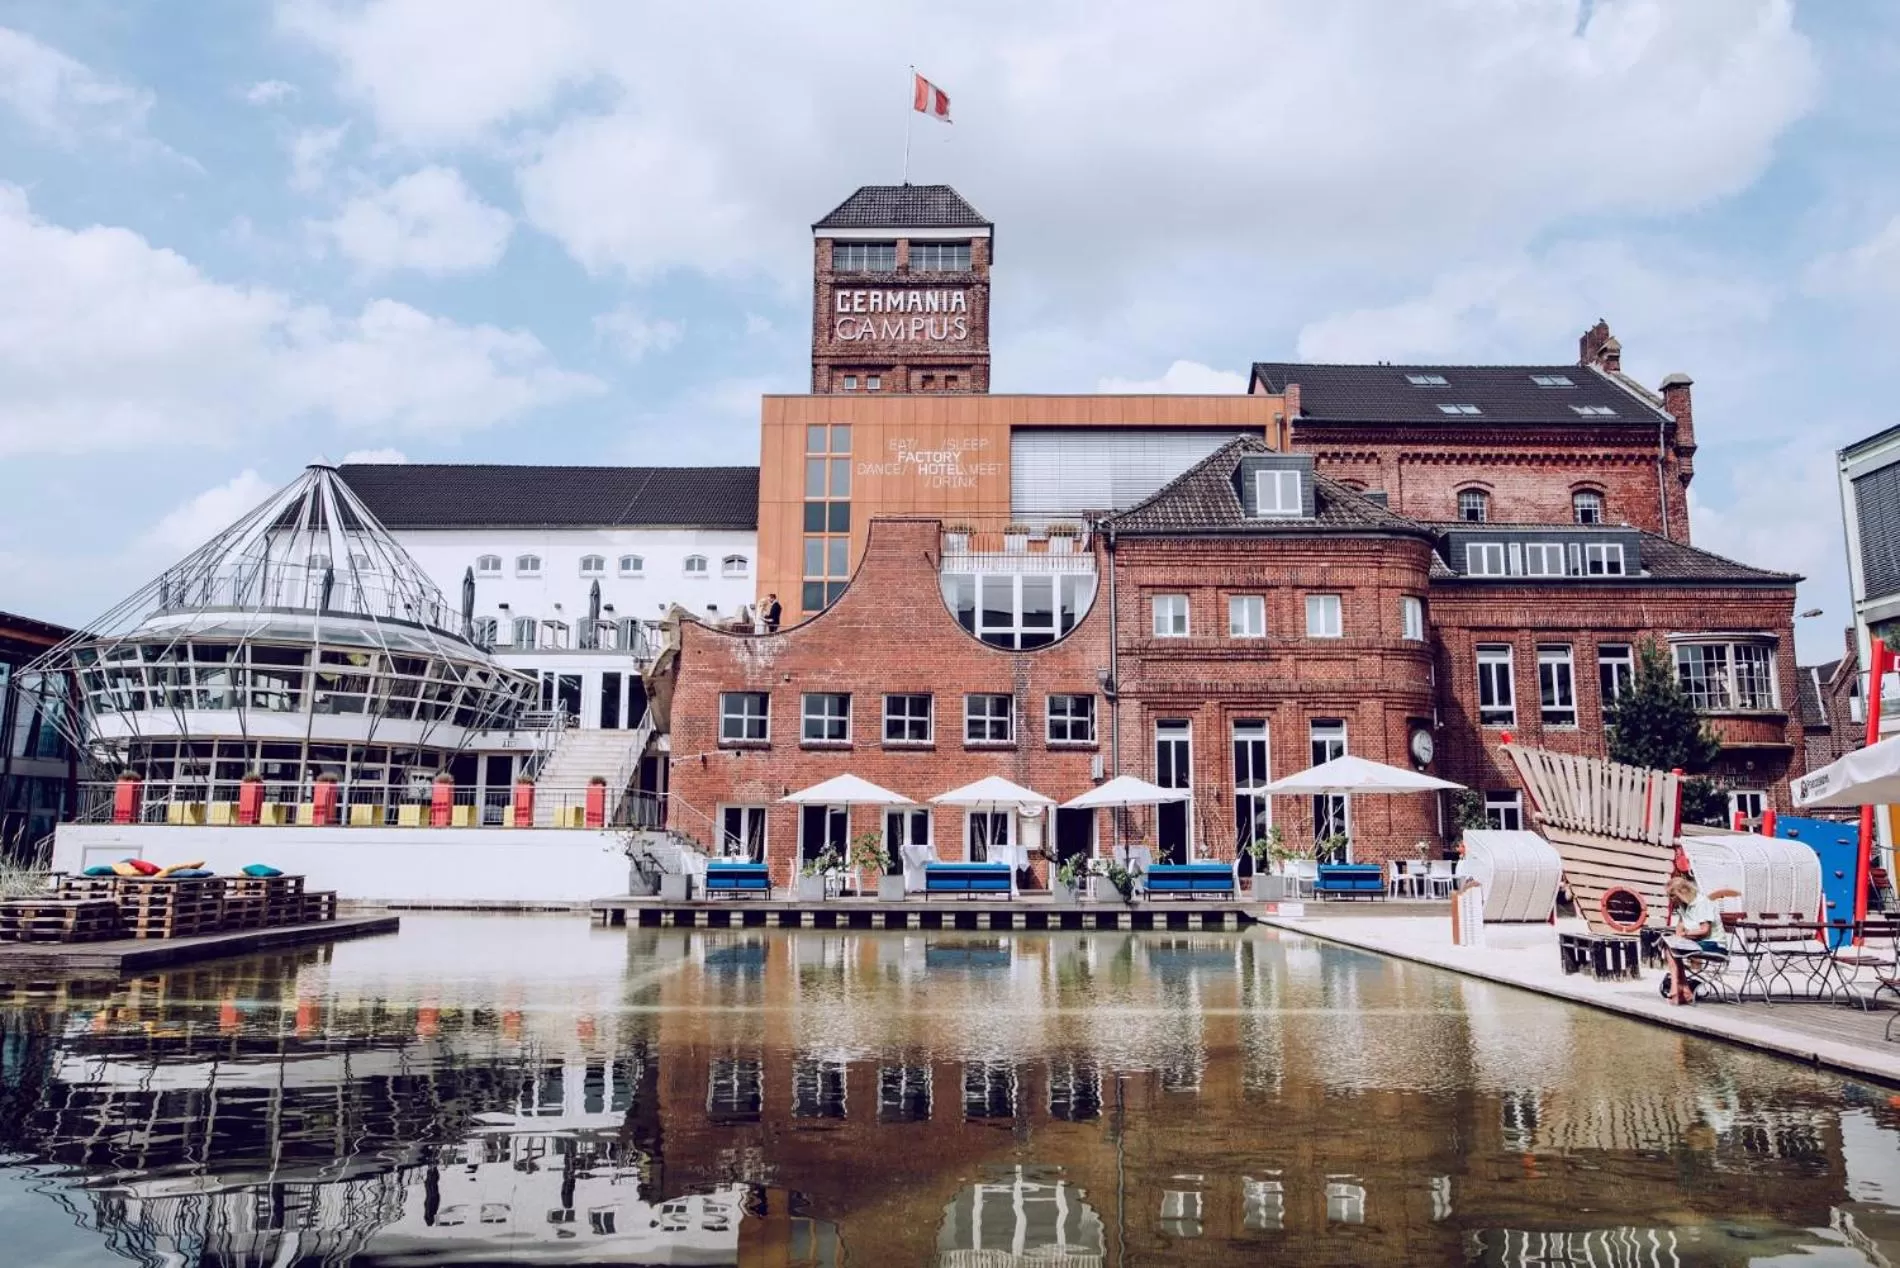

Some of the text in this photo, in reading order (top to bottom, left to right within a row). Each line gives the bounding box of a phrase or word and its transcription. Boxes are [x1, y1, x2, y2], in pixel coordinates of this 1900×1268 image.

[836, 290, 966, 313] GERMANIA
[836, 317, 968, 340] CAMPUS
[898, 451, 962, 463] FACTORY
[918, 463, 963, 475] HOTEL
